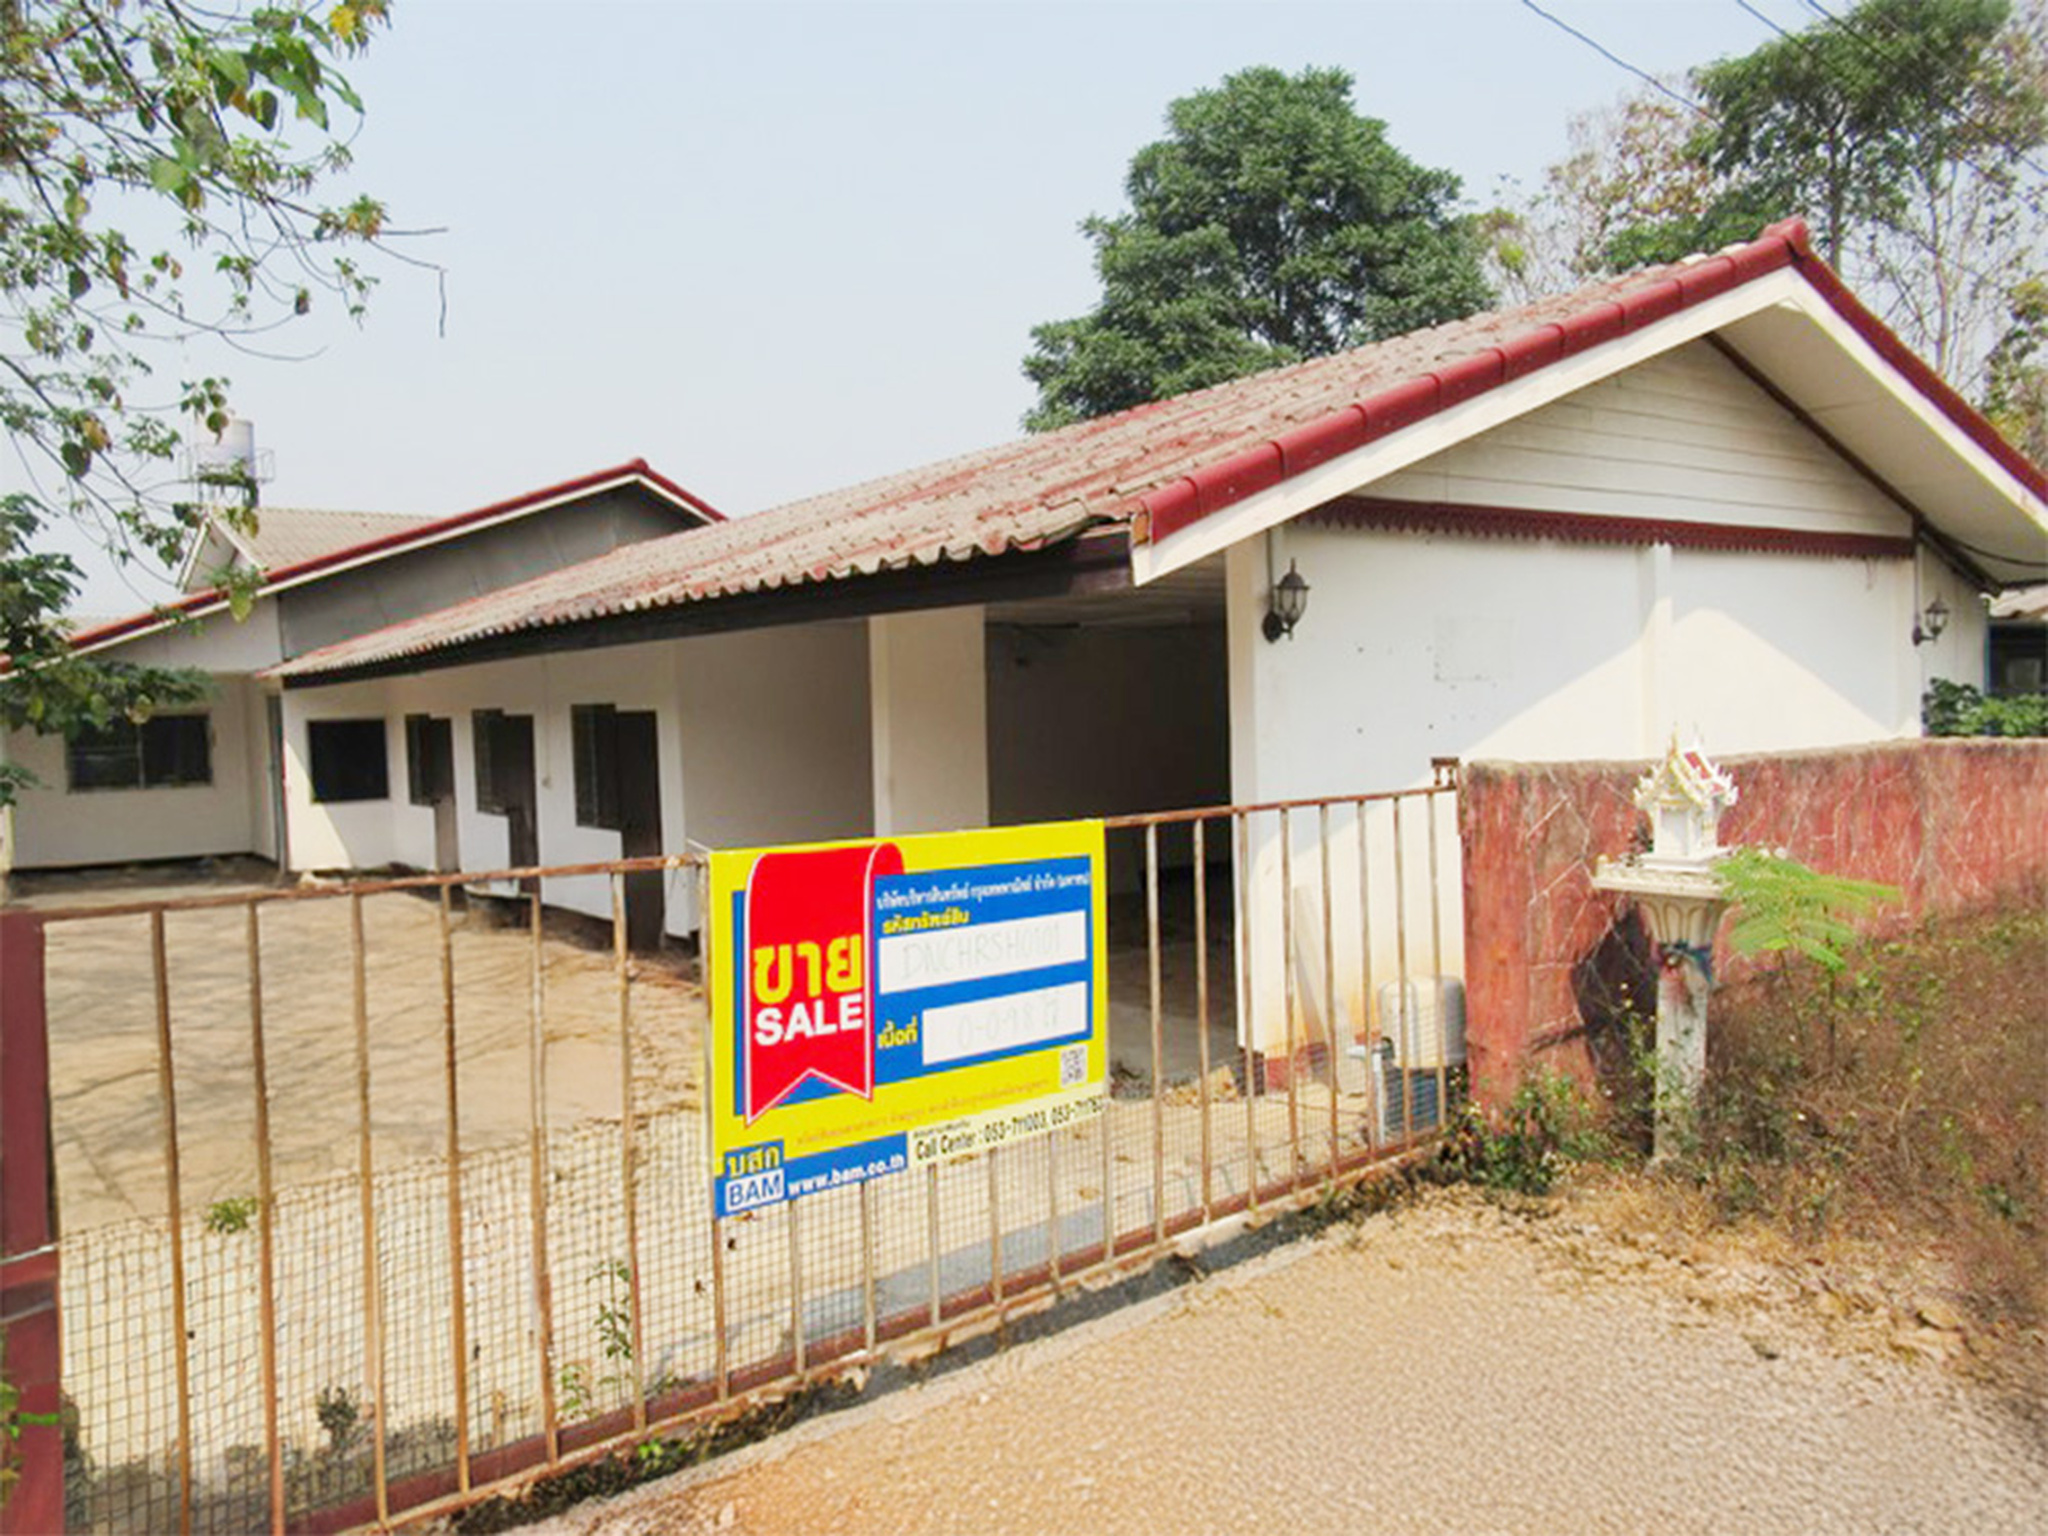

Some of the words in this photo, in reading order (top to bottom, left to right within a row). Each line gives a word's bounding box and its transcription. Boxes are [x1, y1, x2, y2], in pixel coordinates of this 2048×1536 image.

[754, 934, 862, 1004] ขาย
[754, 993, 863, 1046] SALE
[729, 1146, 780, 1178] บสก
[916, 1137, 937, 1160] Call
[729, 1173, 781, 1207] BAM
[788, 1153, 905, 1195] www.bam.co.th
